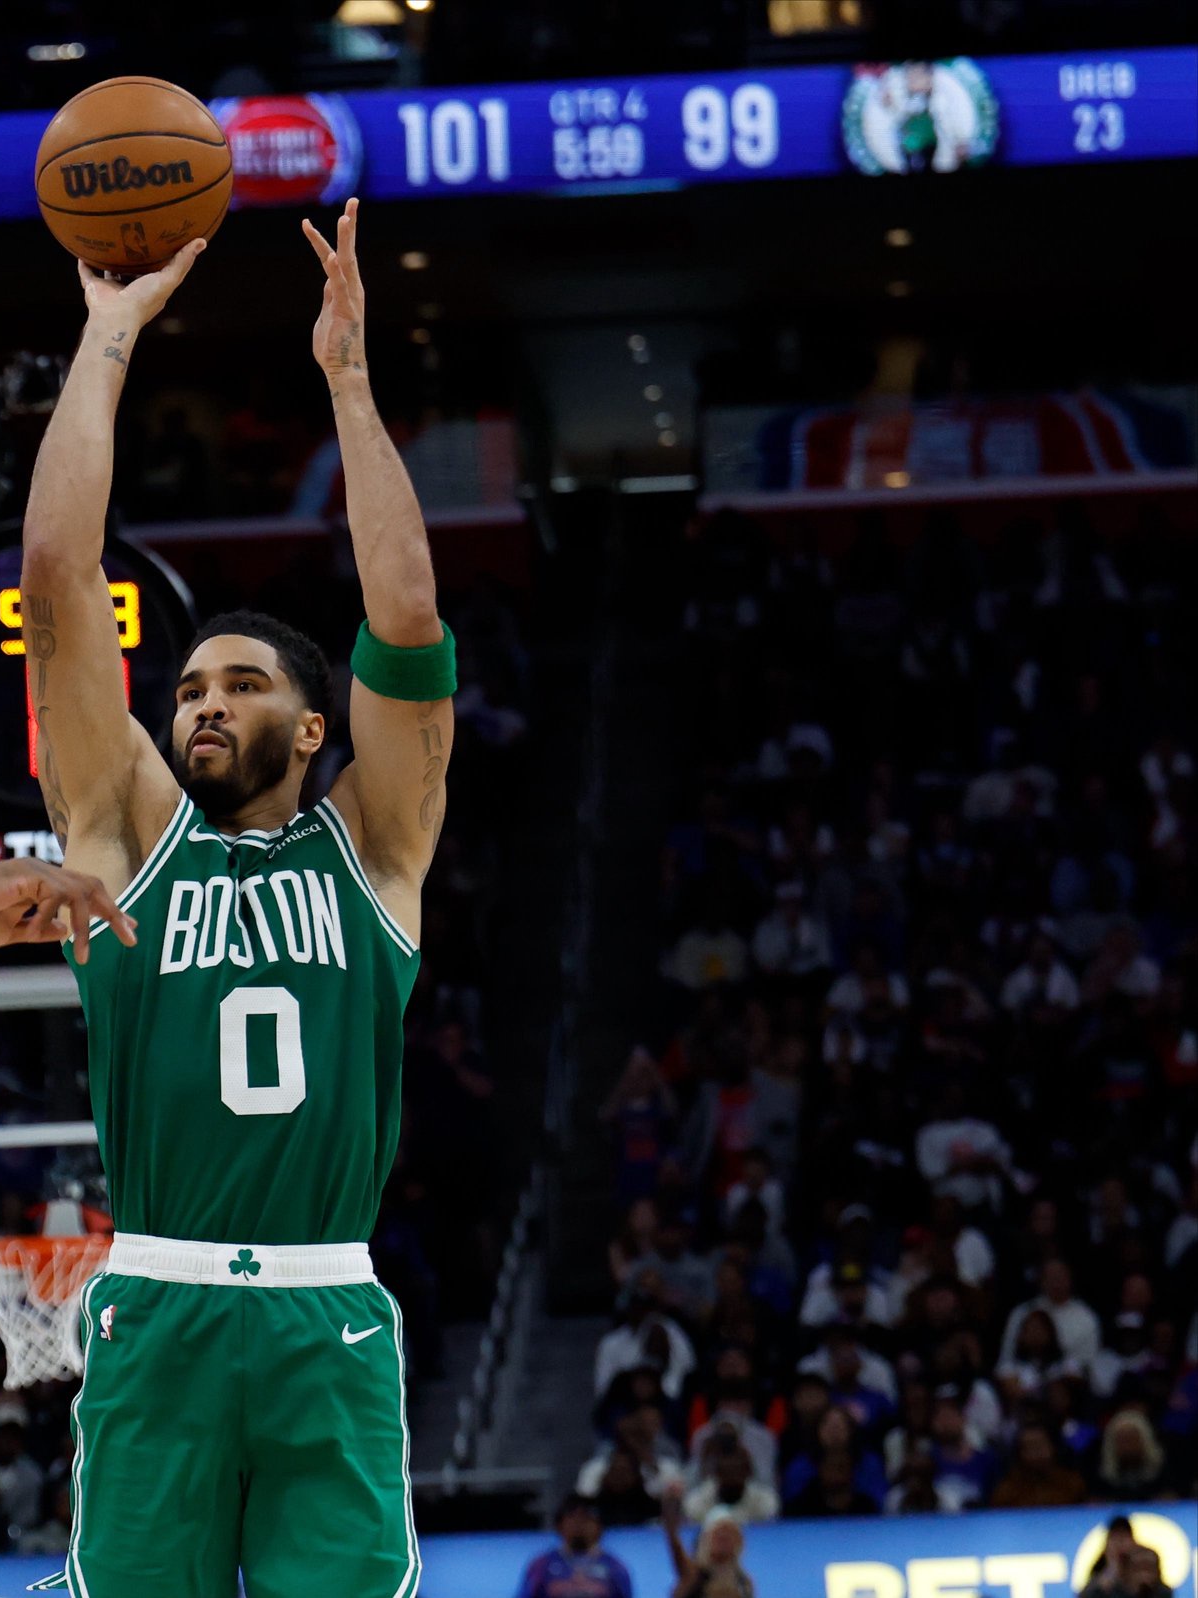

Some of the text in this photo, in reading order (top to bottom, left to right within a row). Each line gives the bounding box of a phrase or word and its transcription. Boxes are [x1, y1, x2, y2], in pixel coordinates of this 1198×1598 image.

[399, 98, 510, 186] 101
[681, 83, 779, 171] 99
[1073, 102, 1125, 152] 23
[61, 156, 194, 198] Wilson
[159, 870, 347, 975] BOSTON
[219, 987, 306, 1115] 0
